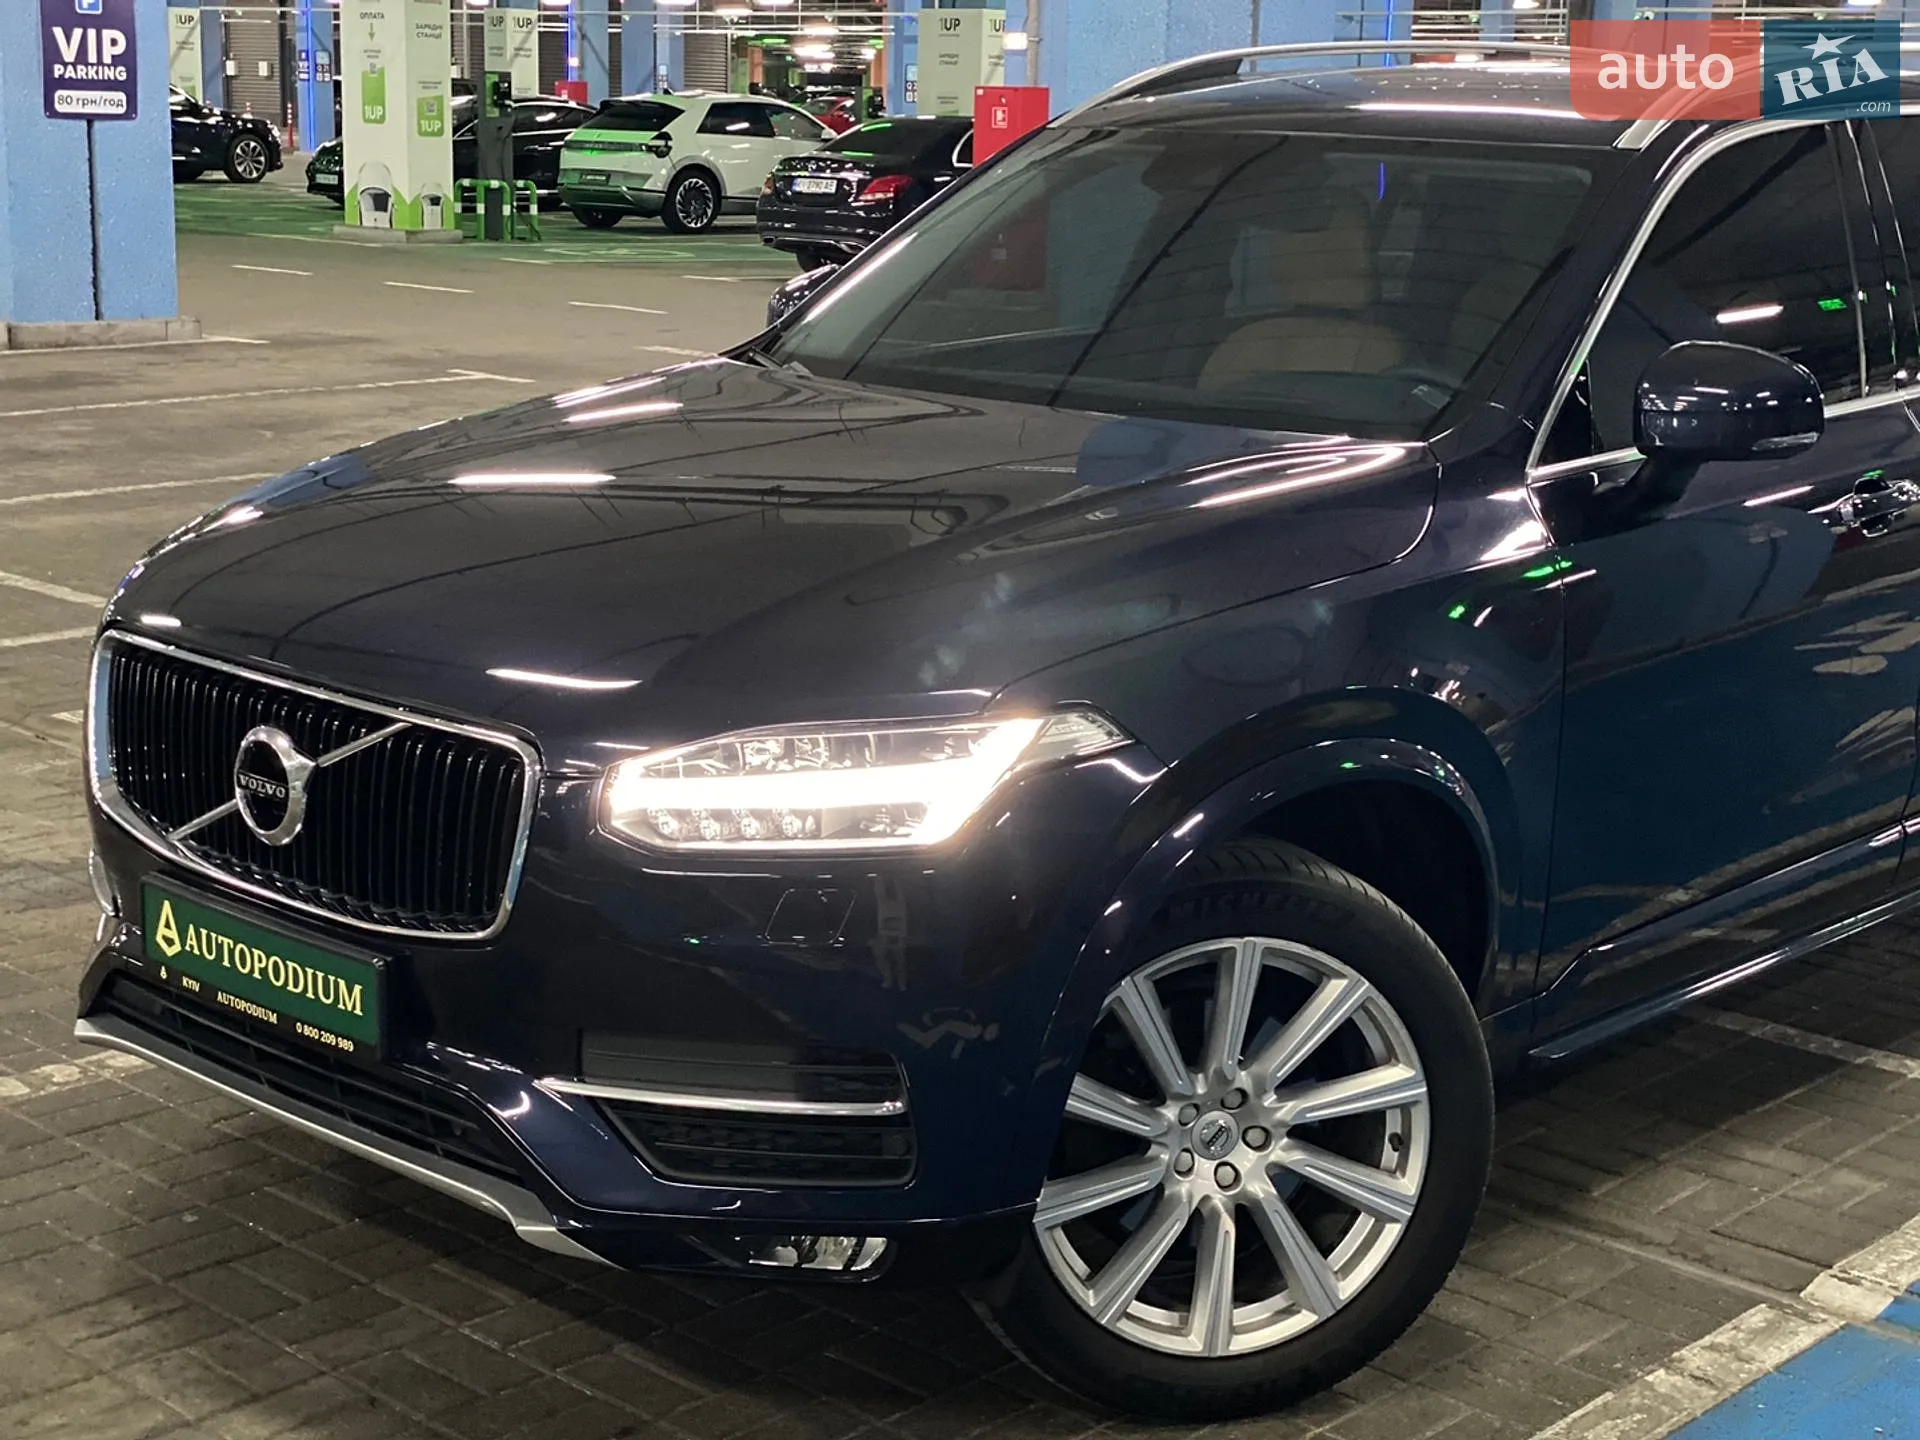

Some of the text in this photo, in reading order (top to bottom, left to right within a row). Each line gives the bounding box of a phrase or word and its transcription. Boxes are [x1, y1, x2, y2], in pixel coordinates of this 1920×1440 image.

[360, 12, 385, 20] ОПЛАТА
[512, 16, 533, 29] 1UP
[939, 17, 961, 31] 1UP
[52, 27, 126, 64] VIP
[53, 64, 127, 81] PARKING
[57, 95, 124, 108] 80 грн/год
[364, 105, 383, 119] 1UP
[420, 120, 441, 132] 1UP
[238, 774, 286, 798] VOLVO
[185, 923, 363, 1016] AUTOPODIUM
[182, 976, 200, 992] KYIV
[217, 991, 278, 1024] AUTOPODIUM
[296, 1022, 354, 1052] 0 800 209 989
